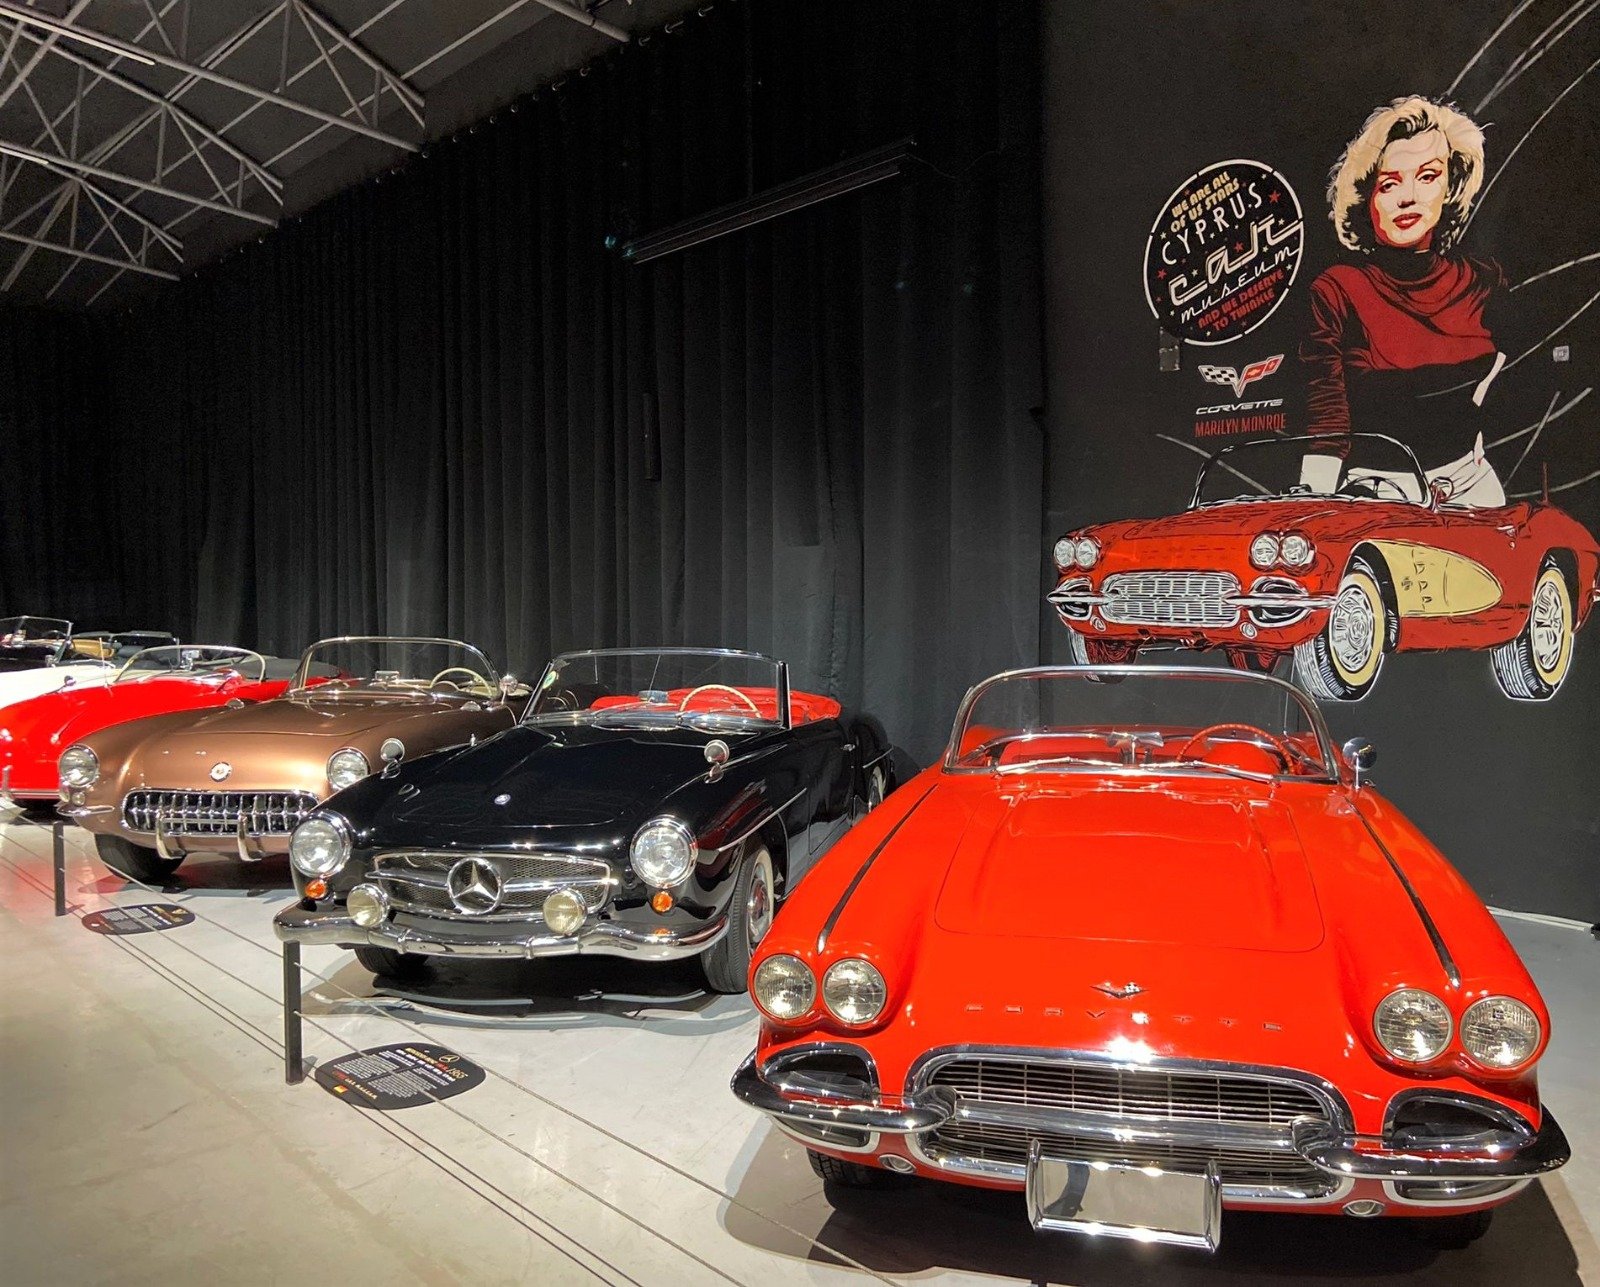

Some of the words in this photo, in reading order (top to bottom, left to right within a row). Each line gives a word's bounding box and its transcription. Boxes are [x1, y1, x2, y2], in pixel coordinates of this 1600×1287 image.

[1170, 214, 1186, 233] OF
[1188, 203, 1203, 221] US
[1204, 177, 1240, 211] STARS
[1171, 199, 1189, 218] WE
[1189, 184, 1212, 206] ARE
[1212, 171, 1231, 190] ALL
[1161, 182, 1263, 266] CYPRUS
[1198, 309, 1220, 329] AND
[1221, 297, 1238, 314] WE
[1238, 269, 1285, 304] DESERVE
[1212, 316, 1230, 331] TO
[1229, 288, 1275, 321] TWINKLE
[1194, 418, 1239, 438] MARILYN
[1241, 412, 1287, 433] MONROE
[1195, 398, 1284, 416] CORVETTE
